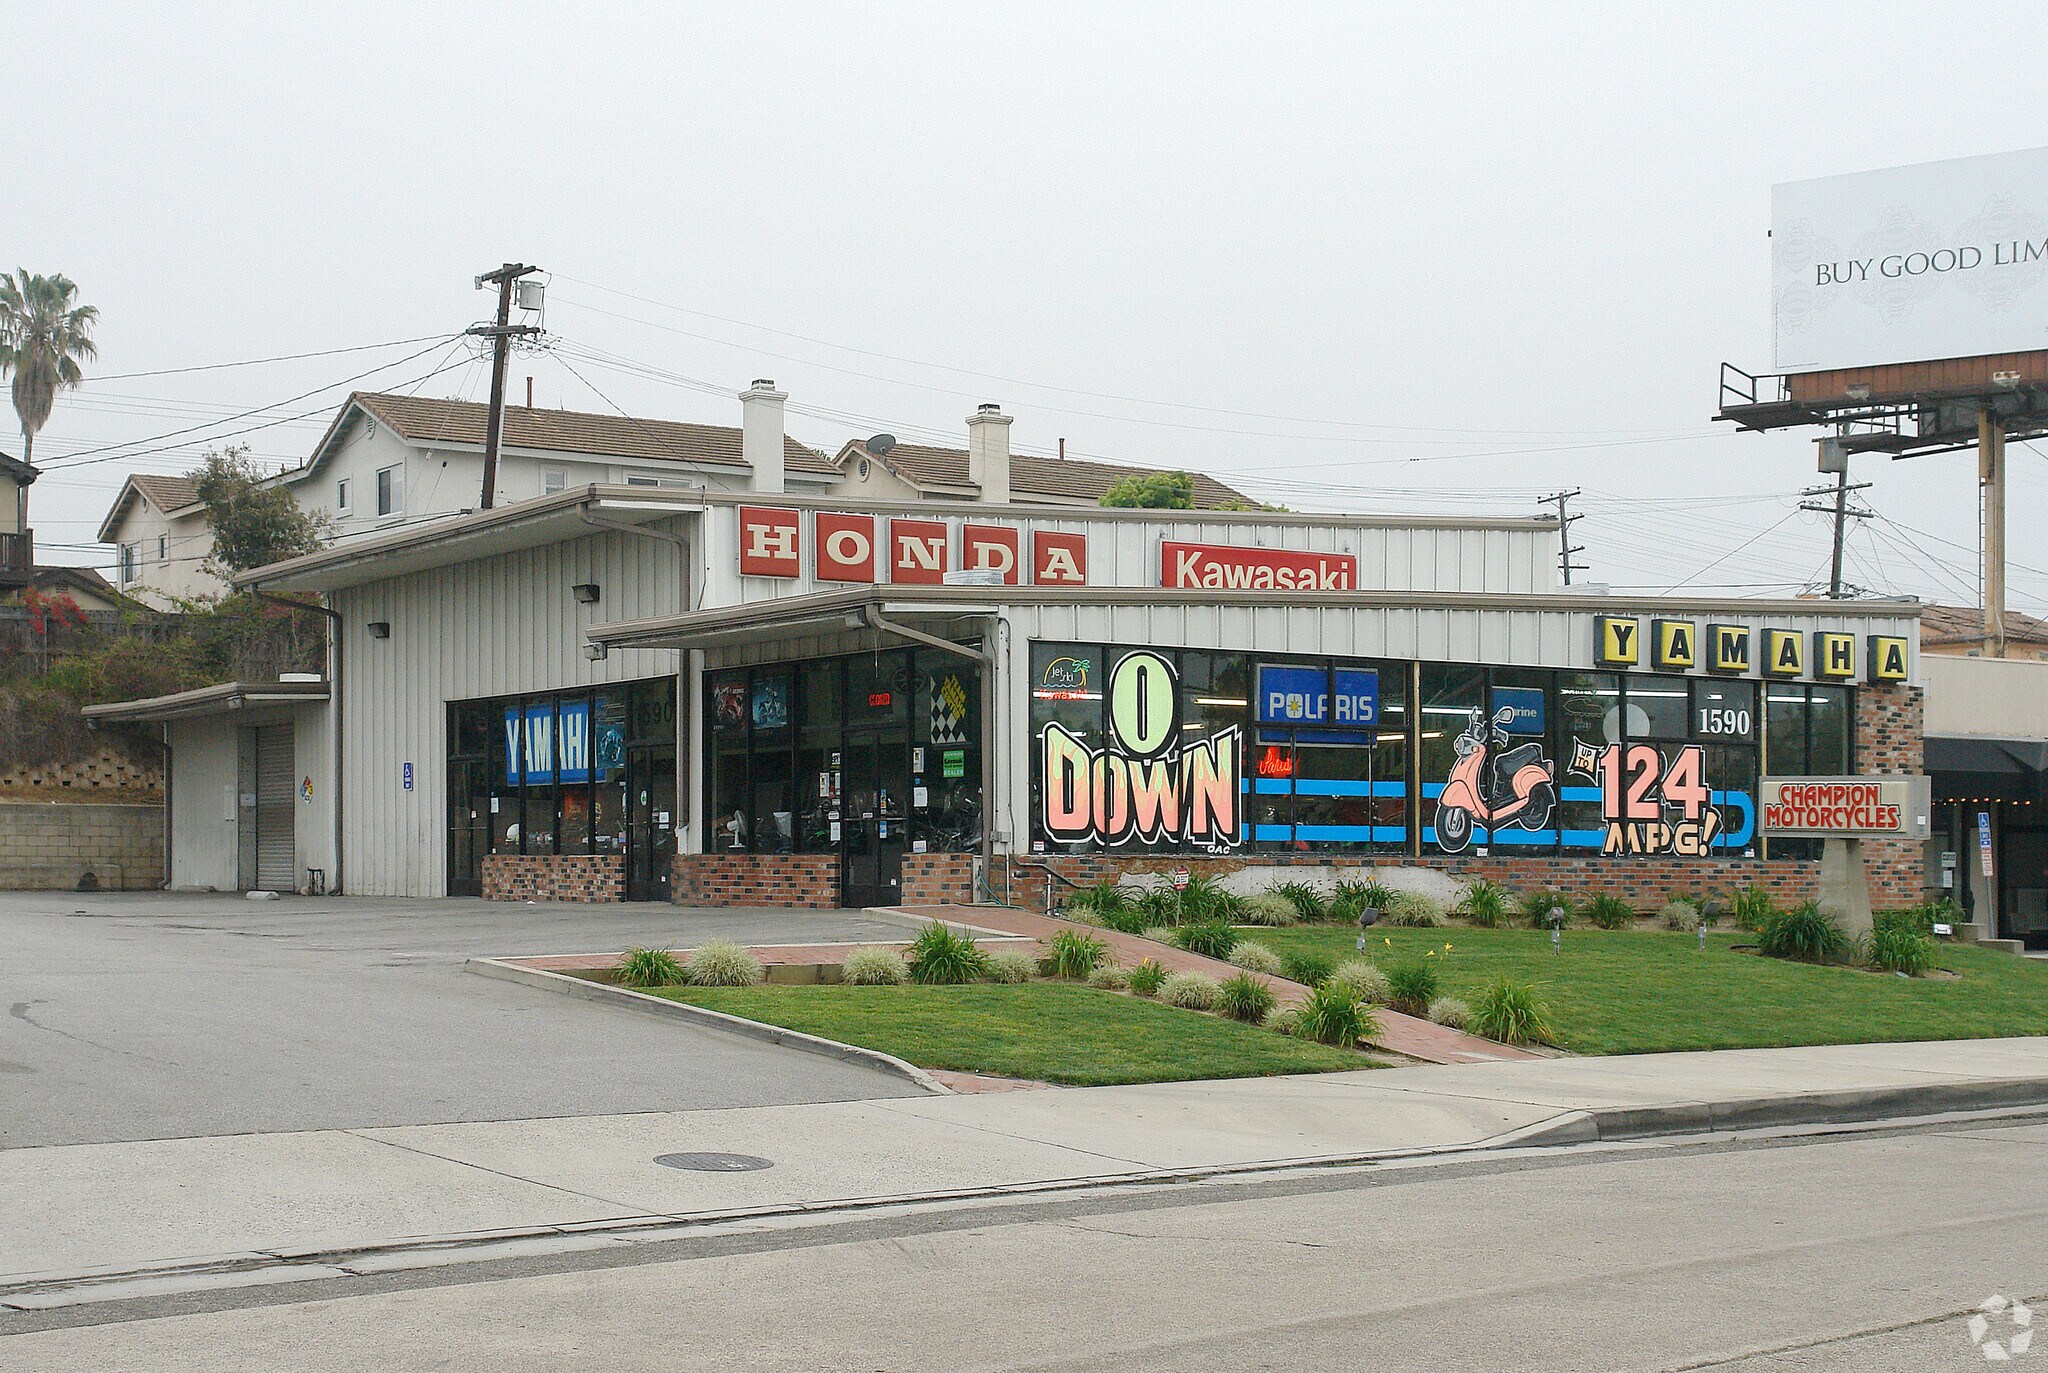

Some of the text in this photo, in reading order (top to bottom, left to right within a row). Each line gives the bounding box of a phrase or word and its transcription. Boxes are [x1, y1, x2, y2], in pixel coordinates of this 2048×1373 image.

[1816, 239, 2048, 286] BUY GOOD LIM
[746, 523, 1085, 582] HONDA
[1176, 550, 1348, 590] Kawasaki
[1611, 623, 1905, 674] YAMAHA
[1269, 692, 1373, 721] POLARIS
[1700, 708, 1751, 736] 1590
[1578, 757, 1590, 769] TO
[1581, 747, 1592, 758] UP
[1044, 724, 1238, 842] DOWN
[1600, 744, 1708, 820] 124
[1766, 806, 1901, 829] MOTORCYCLES
